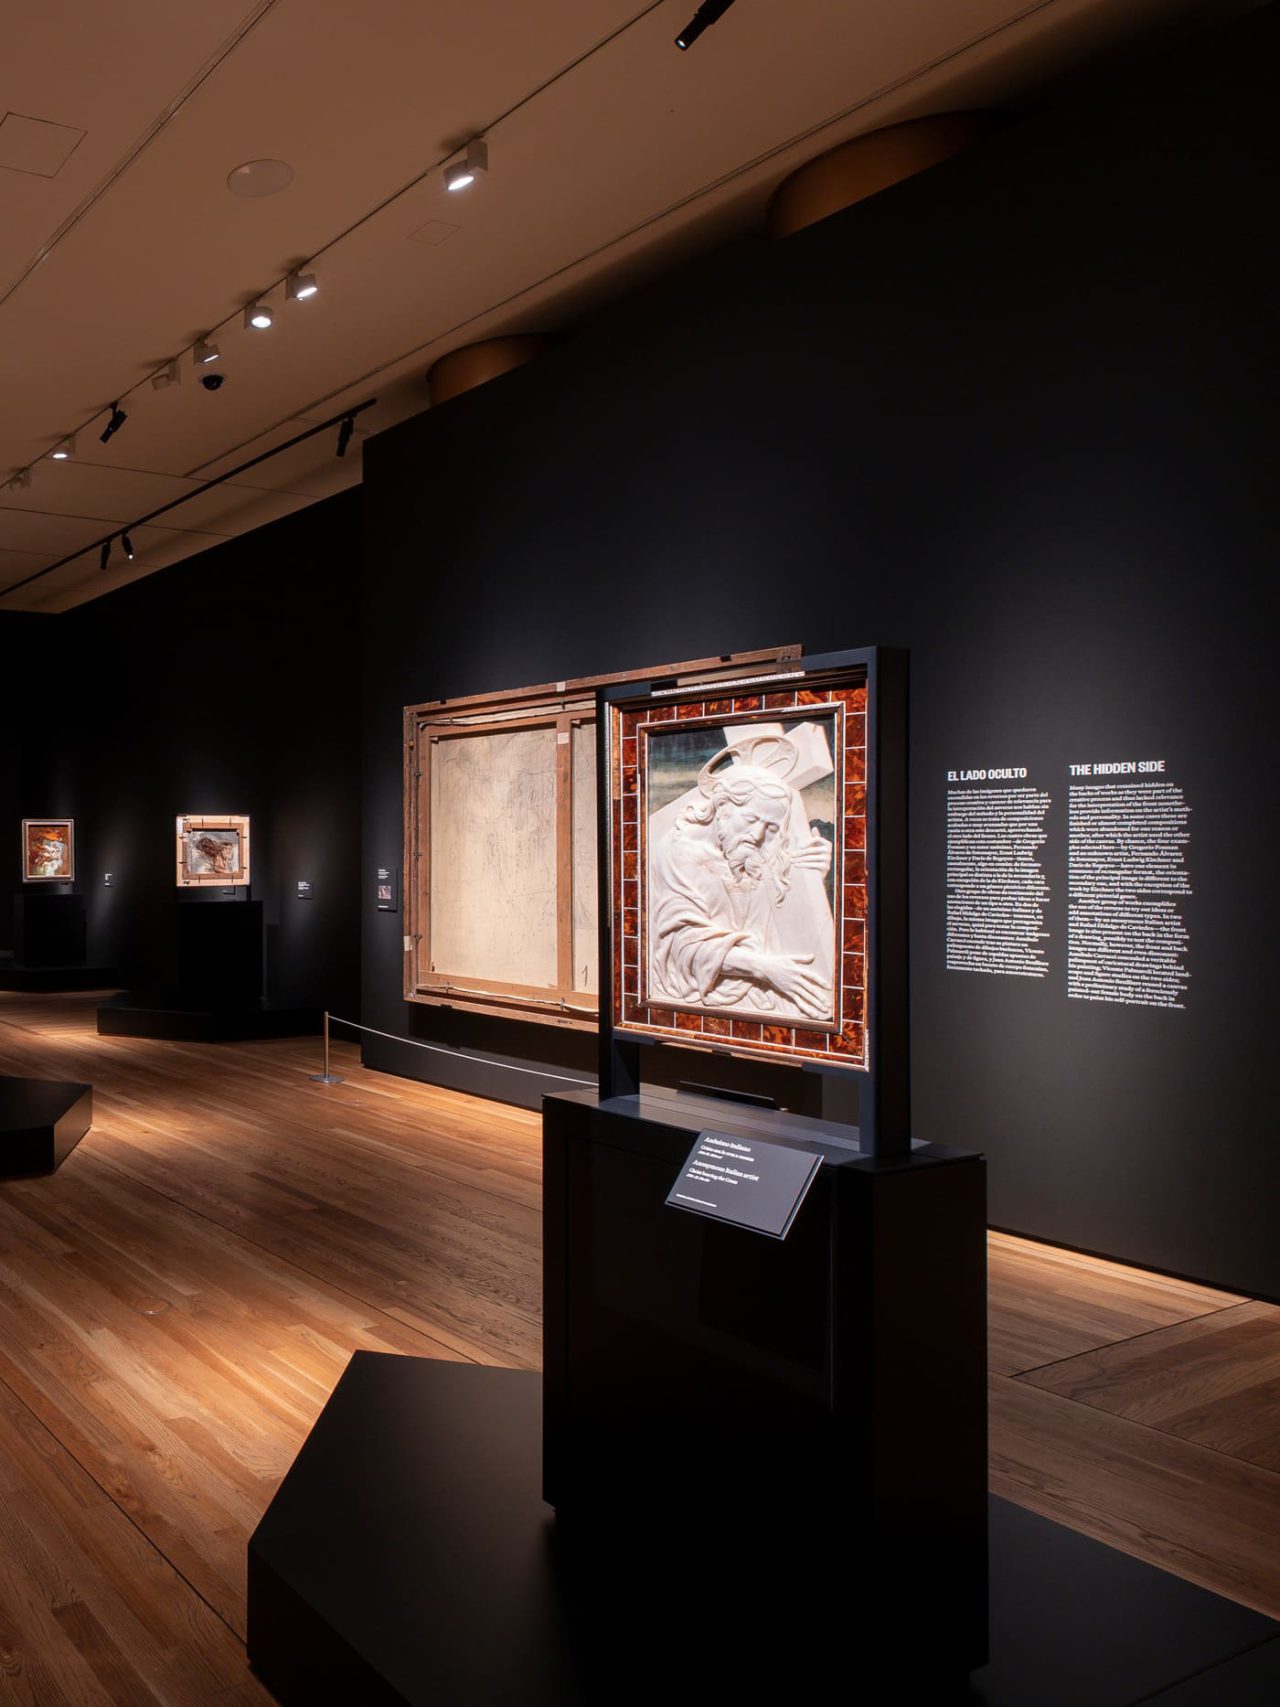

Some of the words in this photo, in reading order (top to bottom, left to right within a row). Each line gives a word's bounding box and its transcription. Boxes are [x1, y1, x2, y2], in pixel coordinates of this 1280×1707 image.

[948, 771, 959, 781] EL
[960, 770, 986, 780] LADO
[988, 768, 1027, 780] OCULTO
[1069, 764, 1092, 776] THE
[1094, 762, 1136, 774] HIDDEN
[1138, 760, 1165, 772] SIDE
